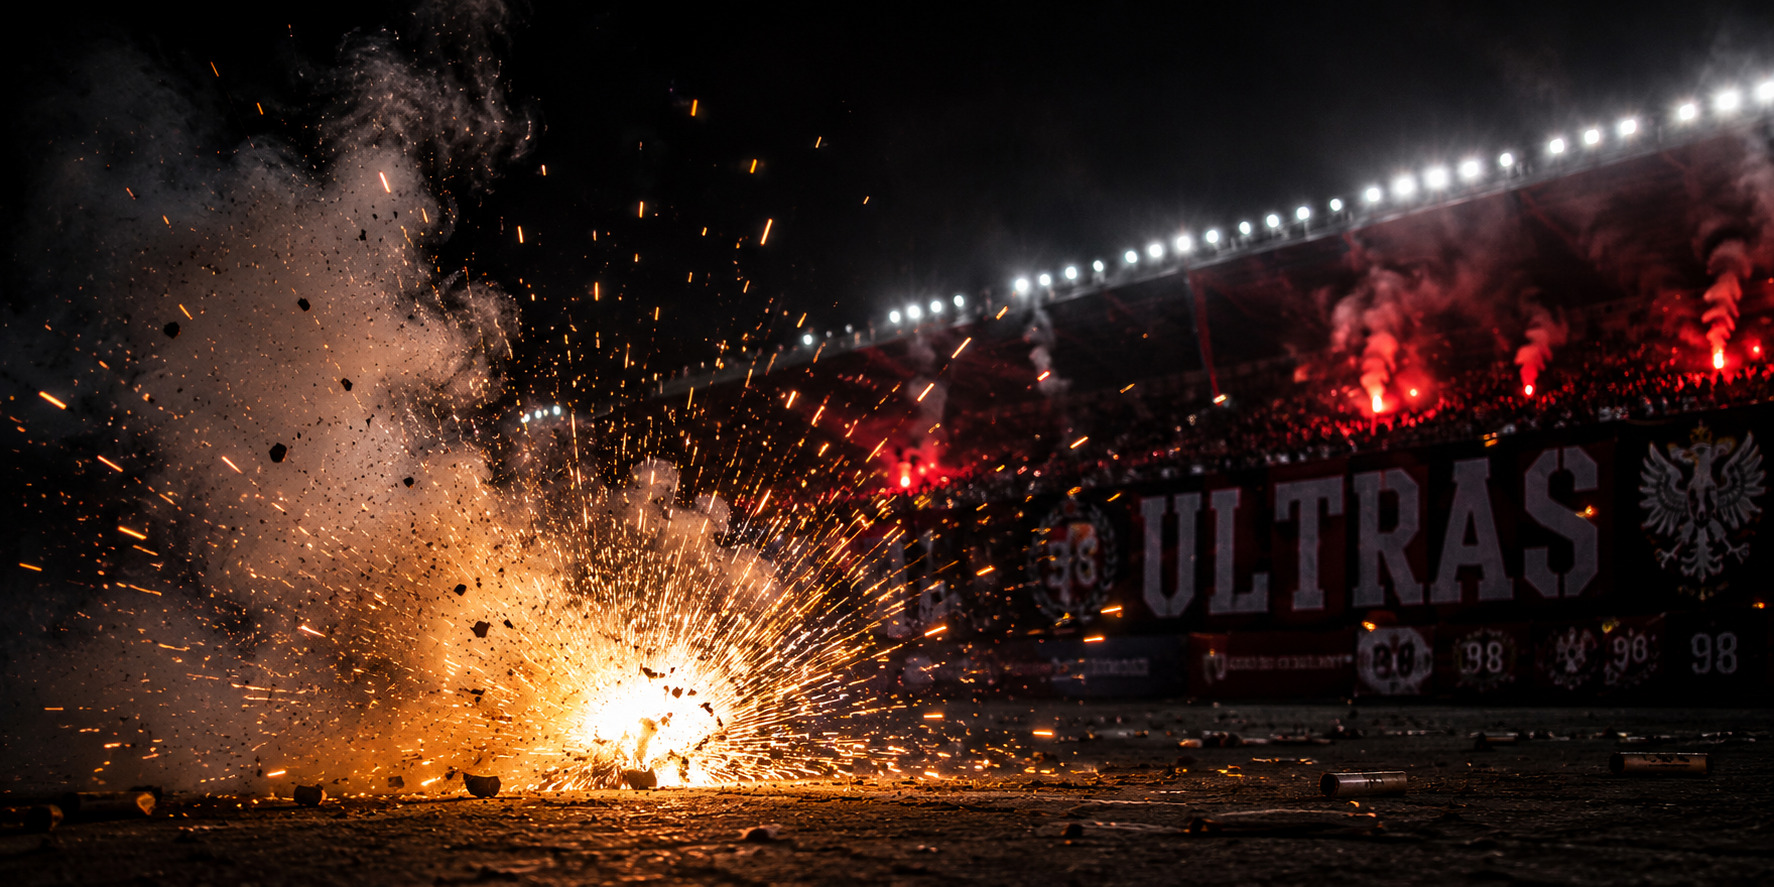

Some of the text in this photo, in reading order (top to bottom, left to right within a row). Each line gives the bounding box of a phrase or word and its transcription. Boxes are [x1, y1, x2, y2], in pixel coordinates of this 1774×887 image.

[1139, 445, 1600, 619] ULTRAS
[1466, 640, 1503, 673] 98
[1613, 633, 1648, 671] 98
[1690, 631, 1738, 674] 98
